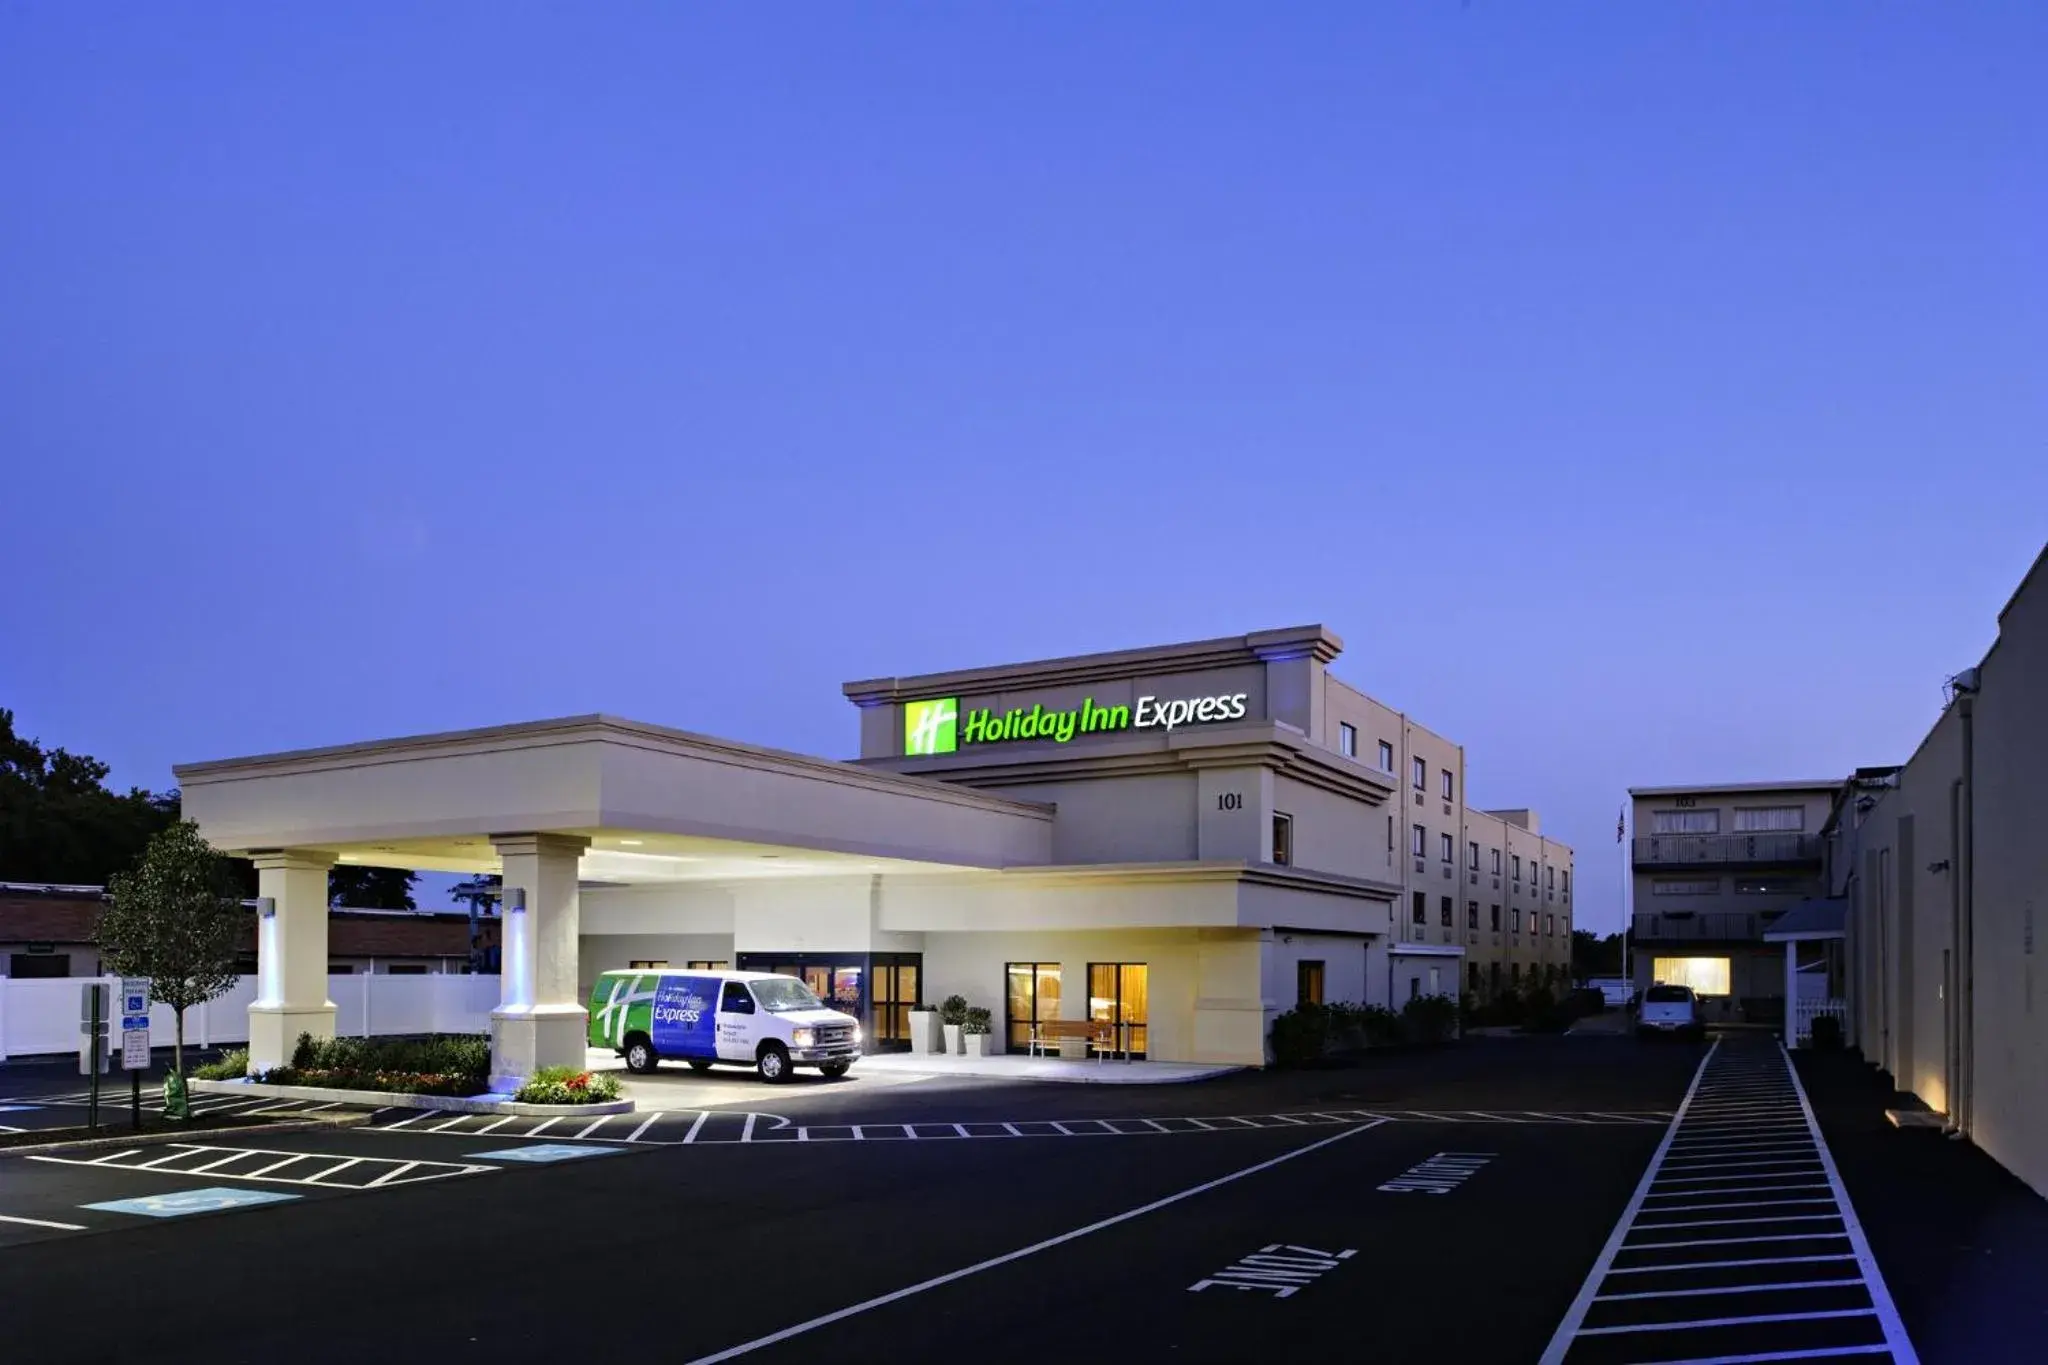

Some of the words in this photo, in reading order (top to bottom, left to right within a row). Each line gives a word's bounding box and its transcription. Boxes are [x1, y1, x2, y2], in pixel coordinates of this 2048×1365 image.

[964, 702, 1076, 742] Holiday
[1080, 697, 1128, 733] Inn
[1134, 692, 1247, 731] Express
[1217, 793, 1243, 810] 101
[655, 1004, 700, 1024] Express
[1186, 1244, 1359, 1298] ZONE
